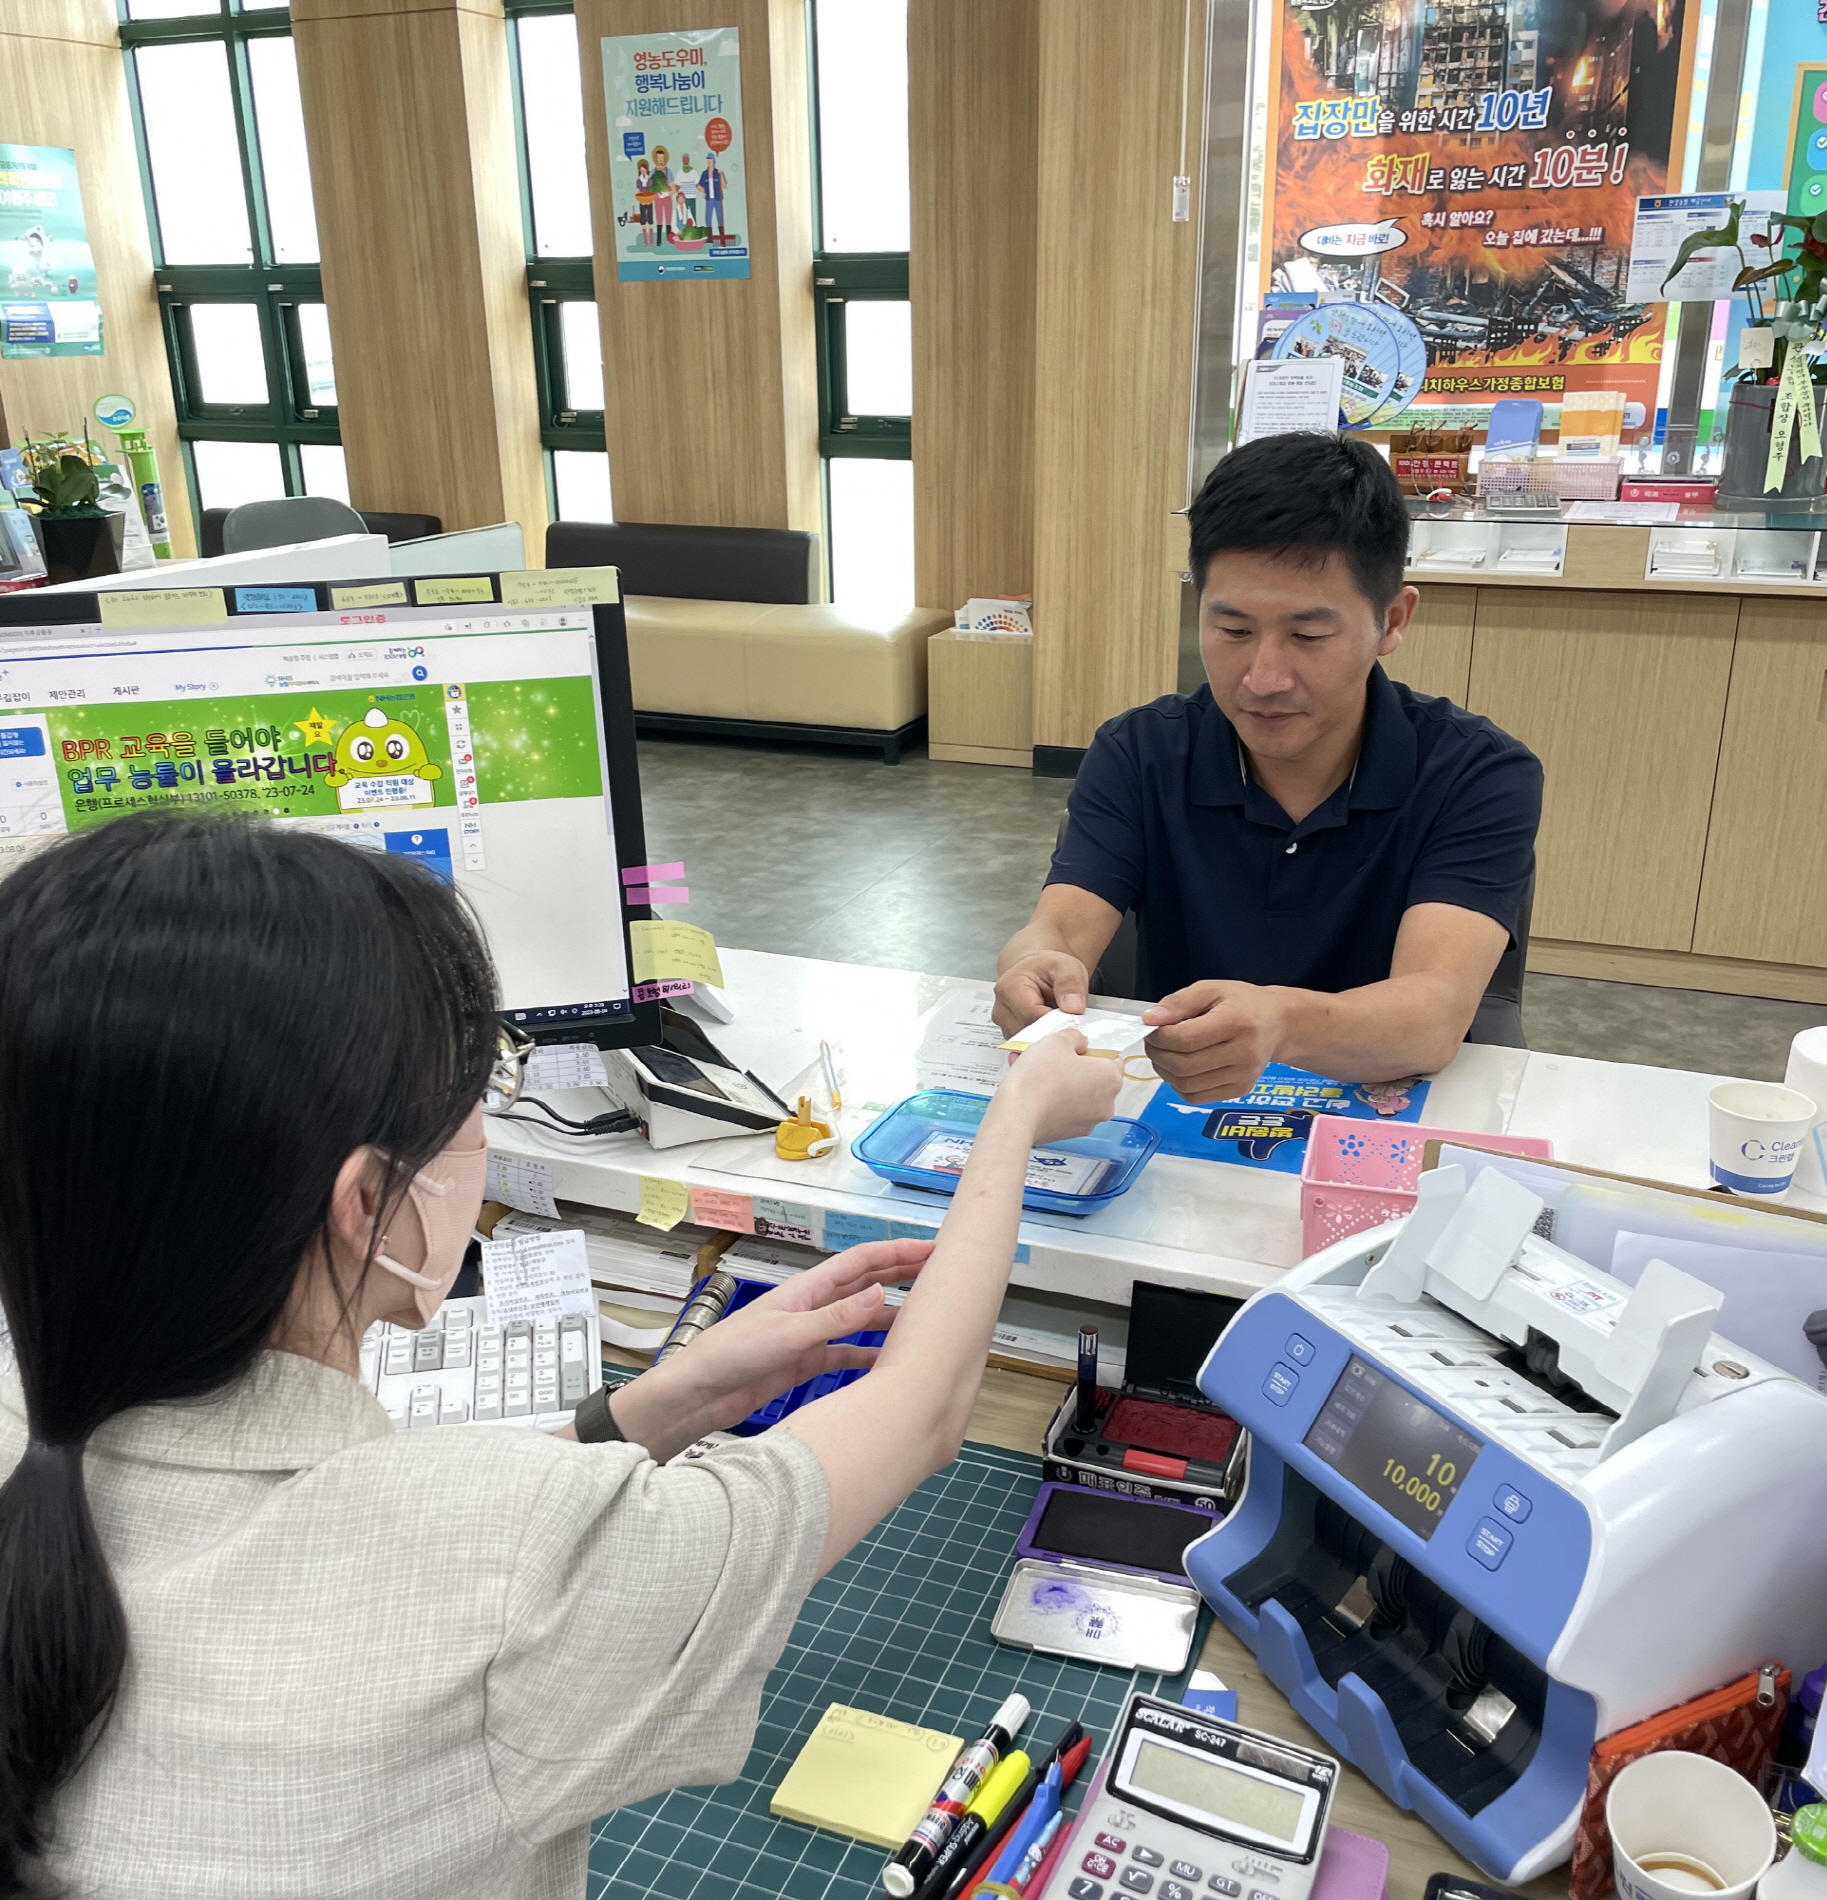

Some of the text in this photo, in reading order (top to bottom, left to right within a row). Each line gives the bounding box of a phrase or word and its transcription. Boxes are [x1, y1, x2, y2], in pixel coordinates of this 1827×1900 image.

[633, 48, 708, 71] 영농도우미,
[634, 71, 706, 93] 행복나눔이
[625, 94, 723, 117] 지원해드립니다
[1293, 86, 1553, 139] 집장만을 위한 시간 10년
[1362, 152, 1444, 195] 화재로
[1449, 167, 1485, 191] 잃는
[1488, 164, 1526, 188] 시간
[1421, 209, 1494, 227] 혹시 알아요?
[1346, 233, 1367, 246] 지금
[1483, 230, 1509, 246] 오늘
[1512, 228, 1537, 244] 집에
[49, 689, 86, 700] 제안관리
[113, 686, 140, 696] 게시판
[175, 684, 187, 693] My
[187, 682, 207, 692] Story
[61, 725, 282, 762] BPR 교육을 들어야
[67, 765, 121, 794] 업무
[128, 759, 206, 790] 능률이
[354, 781, 369, 789] 교육
[385, 779, 399, 787] 직원
[401, 778, 415, 787] 대상
[364, 788, 385, 796] 이벤트
[1220, 1126, 1294, 1139] 병원비
[1270, 1382, 1286, 1396] STOP
[1273, 1370, 1292, 1388] START
[1426, 1452, 1457, 1486] 10
[1382, 1458, 1442, 1512] 10,000
[1480, 1526, 1505, 1547] START
[1476, 1539, 1497, 1557] STOP
[1135, 1707, 1227, 1749] SCALAR SC-247
[1101, 1834, 1121, 1848] AC
[936, 1841, 959, 1866] SUPER
[1175, 1861, 1196, 1877] MU
[1216, 1877, 1234, 1891] GT
[1079, 1881, 1093, 1895] 7
